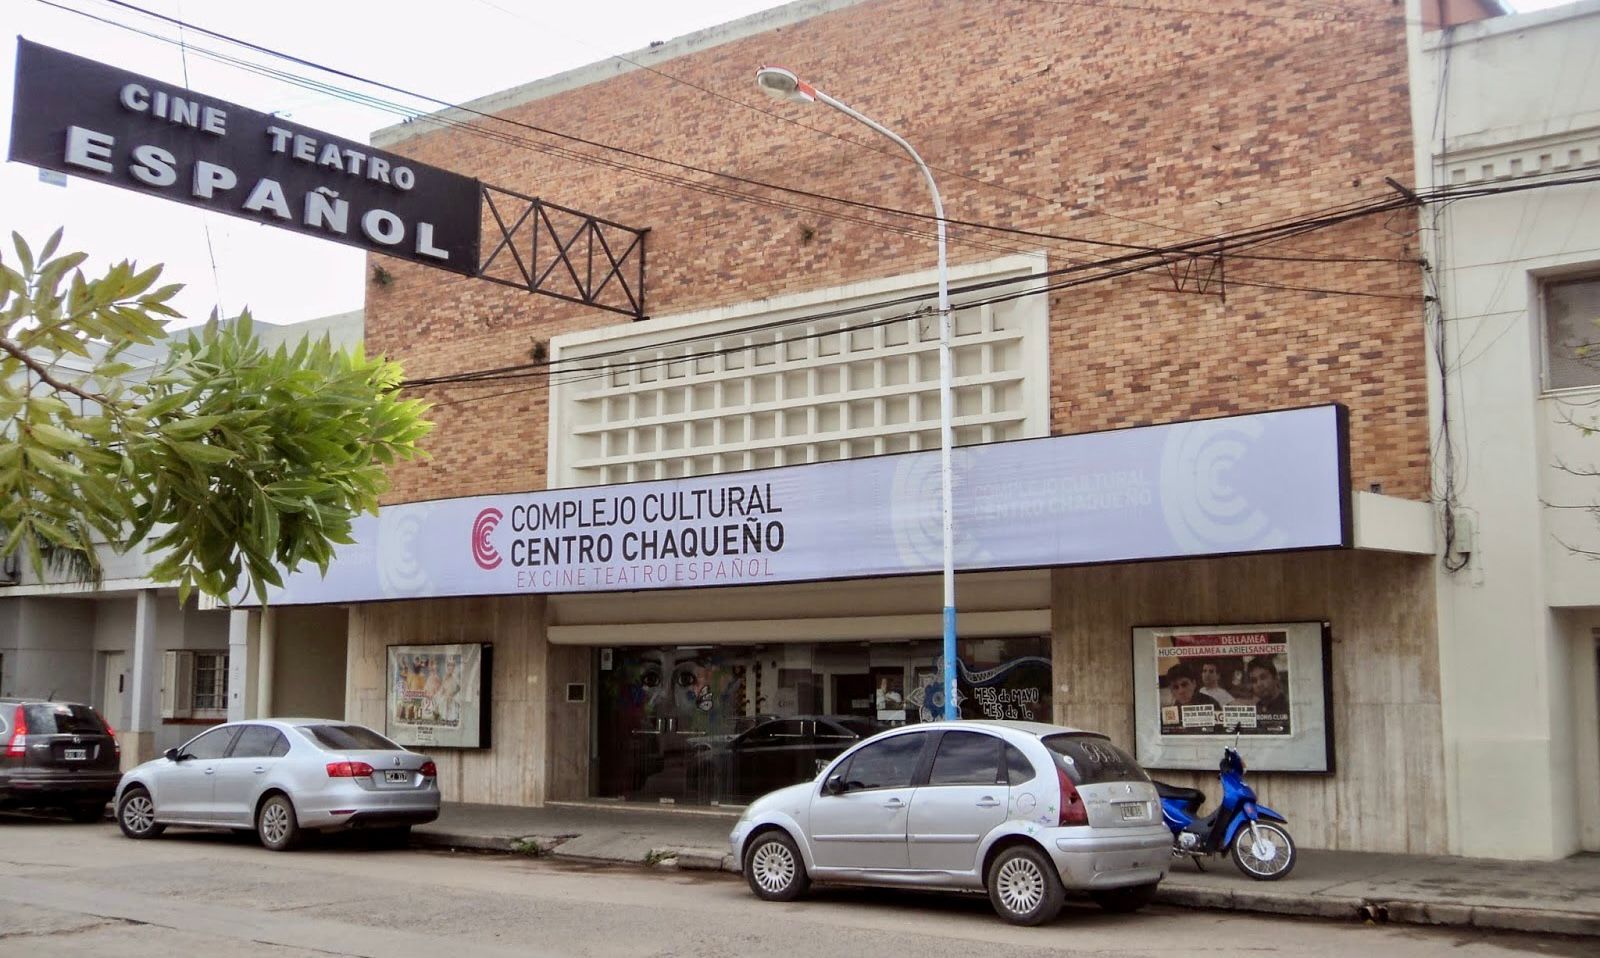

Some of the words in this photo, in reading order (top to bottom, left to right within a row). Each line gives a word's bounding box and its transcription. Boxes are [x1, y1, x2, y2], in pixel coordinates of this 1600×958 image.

[120, 83, 227, 136] CINE
[267, 125, 415, 191] TEATRO
[65, 125, 449, 259] ESPAÑOL
[512, 496, 636, 532] COMPLEJO
[643, 483, 783, 523] CULTURAL
[511, 533, 613, 567] CENTRO
[622, 517, 785, 562] CHAQUEÑO
[517, 571, 537, 588] EX
[542, 566, 586, 587] CINE
[593, 563, 668, 585] TEATRO
[675, 558, 775, 582] ESPAÑOL
[1221, 635, 1266, 645] DELLAMEA
[974, 687, 997, 704] MES
[998, 688, 1010, 703] de
[1011, 687, 1039, 706] MAYO
[983, 701, 1004, 720] MES
[1005, 705, 1018, 719] de
[1021, 704, 1034, 720] la
